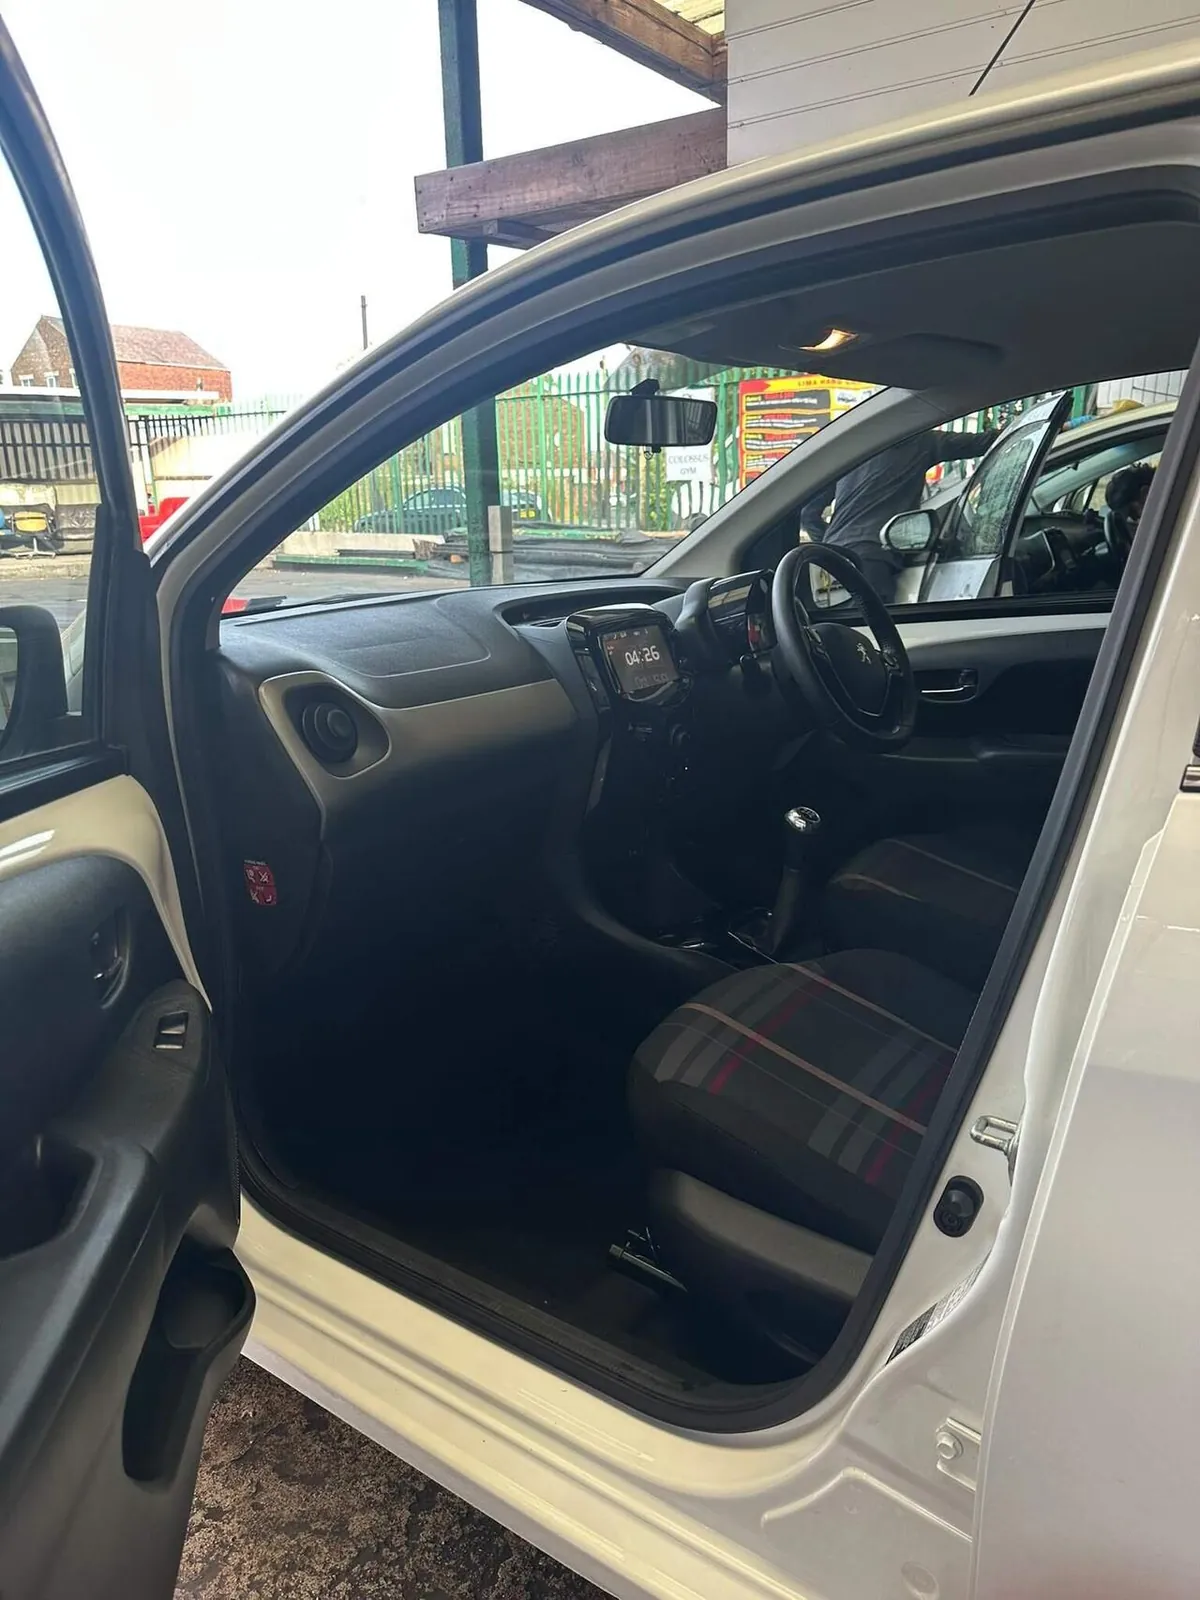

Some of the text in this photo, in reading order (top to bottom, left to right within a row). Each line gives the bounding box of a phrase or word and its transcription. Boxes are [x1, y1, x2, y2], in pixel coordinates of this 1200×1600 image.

[668, 453, 709, 464] COLOSSUS
[680, 466, 697, 475] GYM
[625, 645, 660, 666] 04:26
